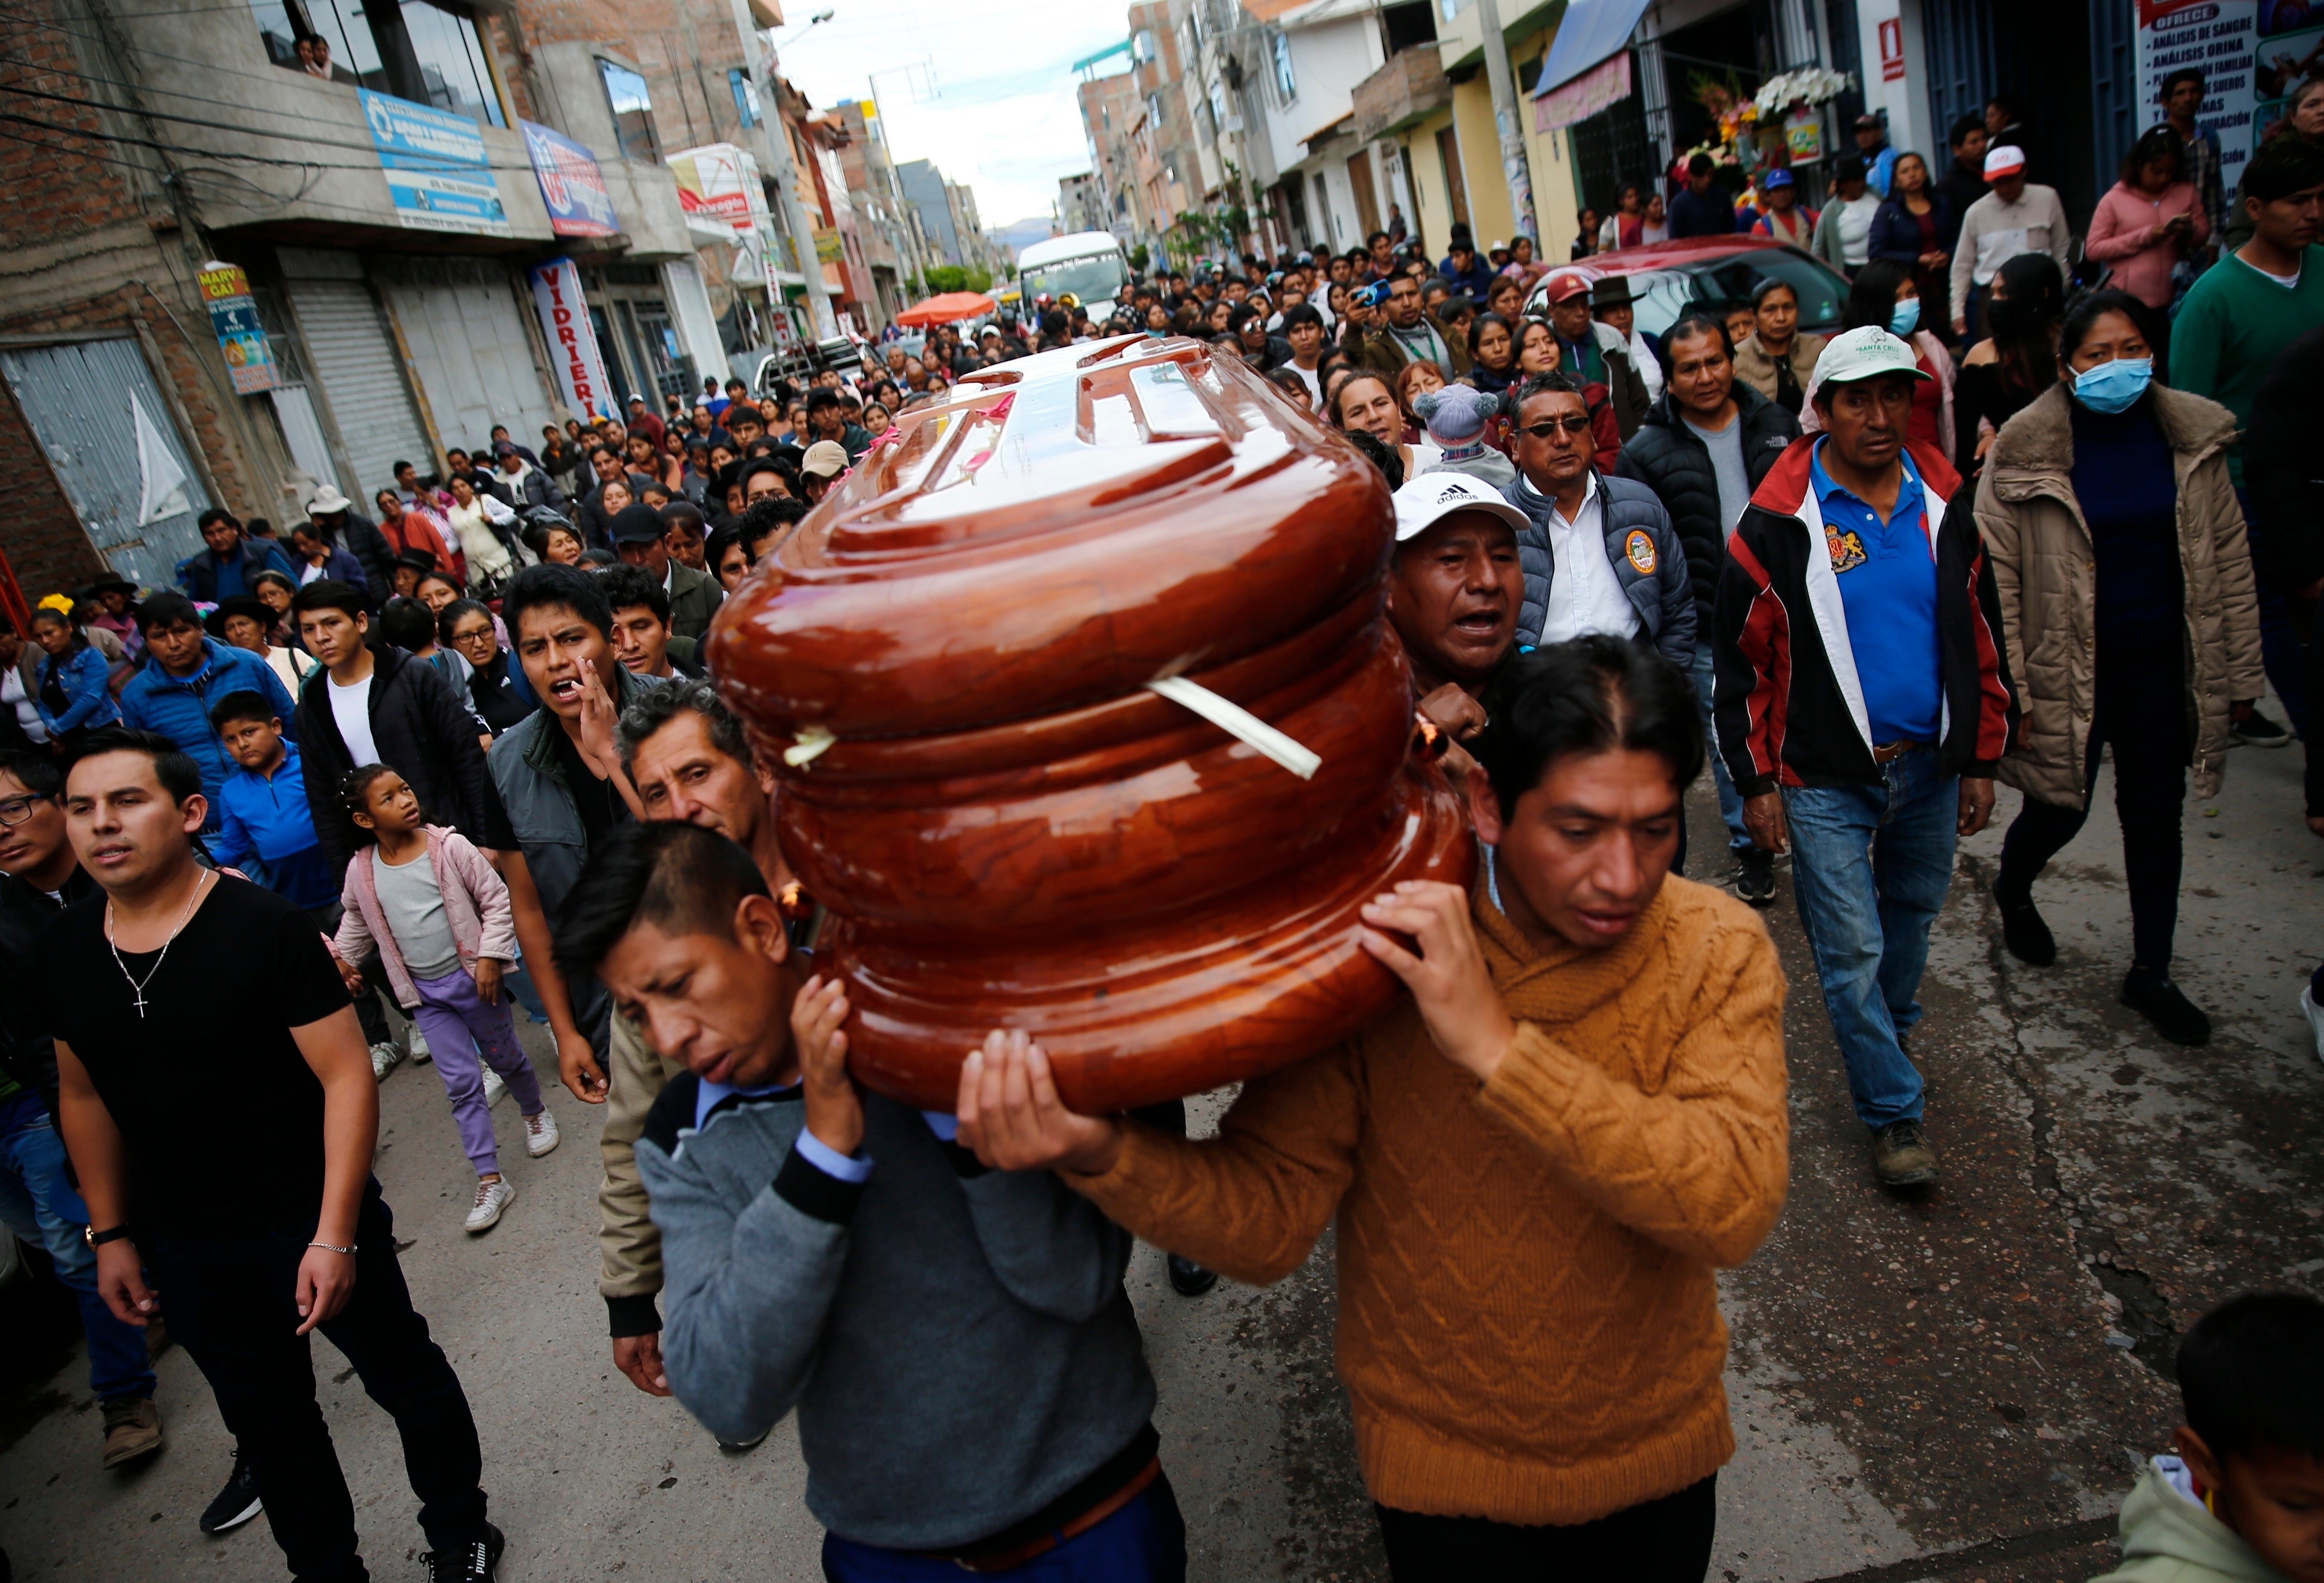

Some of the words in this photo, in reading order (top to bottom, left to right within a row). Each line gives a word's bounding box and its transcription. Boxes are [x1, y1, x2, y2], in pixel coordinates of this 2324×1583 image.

[2156, 7, 2214, 29] OFRECE:
[2154, 28, 2197, 50] ANÁLISIS
[2199, 26, 2211, 40] DE
[2213, 16, 2253, 35] SANGRE
[2154, 46, 2204, 68] ANÁLISIS
[2207, 37, 2244, 57] ORINA
[2215, 55, 2253, 75] FAMILIAR
[2213, 75, 2246, 93] SUEROS
[198, 268, 236, 286] MARY
[209, 282, 235, 297] GAS
[539, 266, 597, 425] VIDRIERI
[1437, 493, 1478, 504] adidas
[476, 1542, 486, 1574] PUMA
